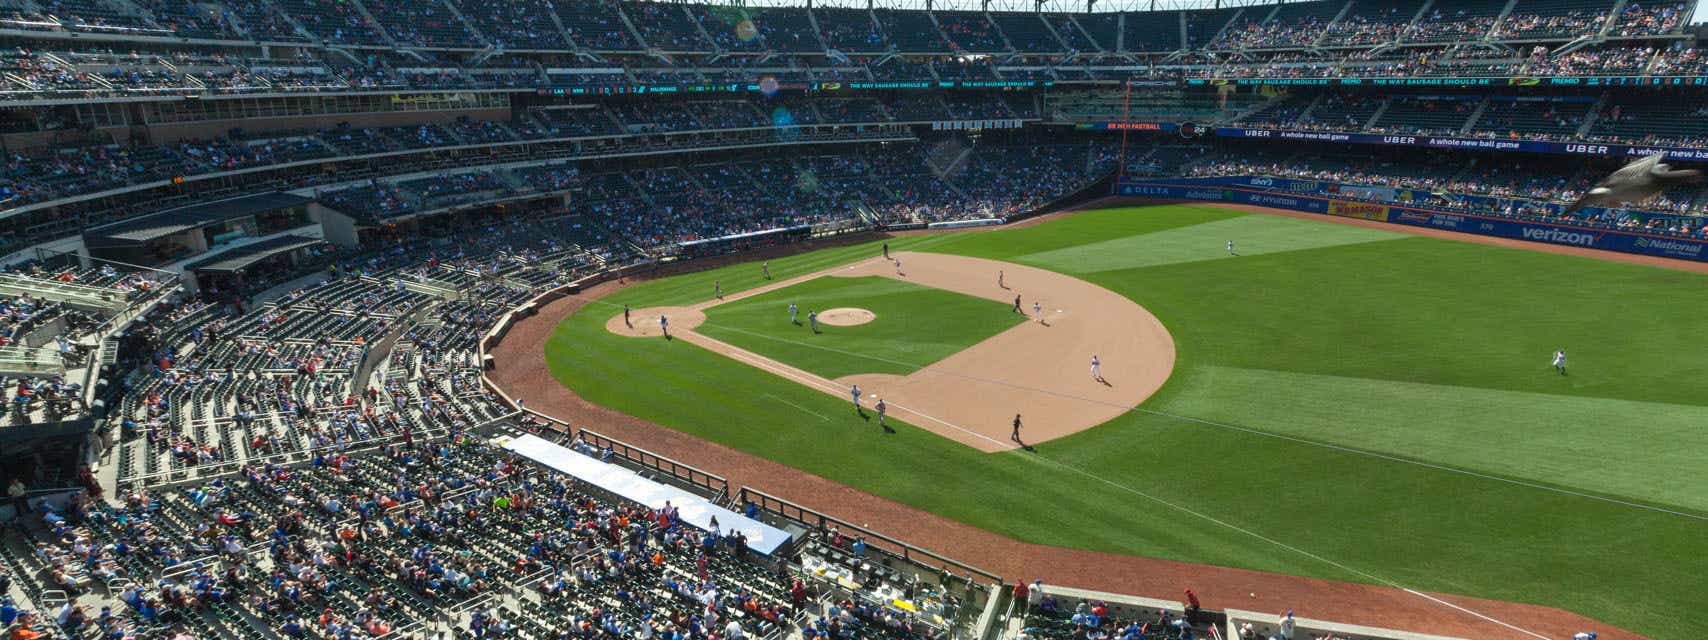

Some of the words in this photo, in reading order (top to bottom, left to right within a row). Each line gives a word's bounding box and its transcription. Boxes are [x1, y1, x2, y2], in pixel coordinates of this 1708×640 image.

[1384, 136, 1416, 144] UBER
[1479, 140, 1495, 148] ball
[1566, 144, 1608, 154] UBER
[1627, 147, 1636, 155] A
[1670, 150, 1694, 158] new
[1135, 186, 1169, 194] DELTA
[1263, 196, 1297, 206] HYUNDAI
[1522, 227, 1594, 246] verizon
[1649, 239, 1703, 253] National
